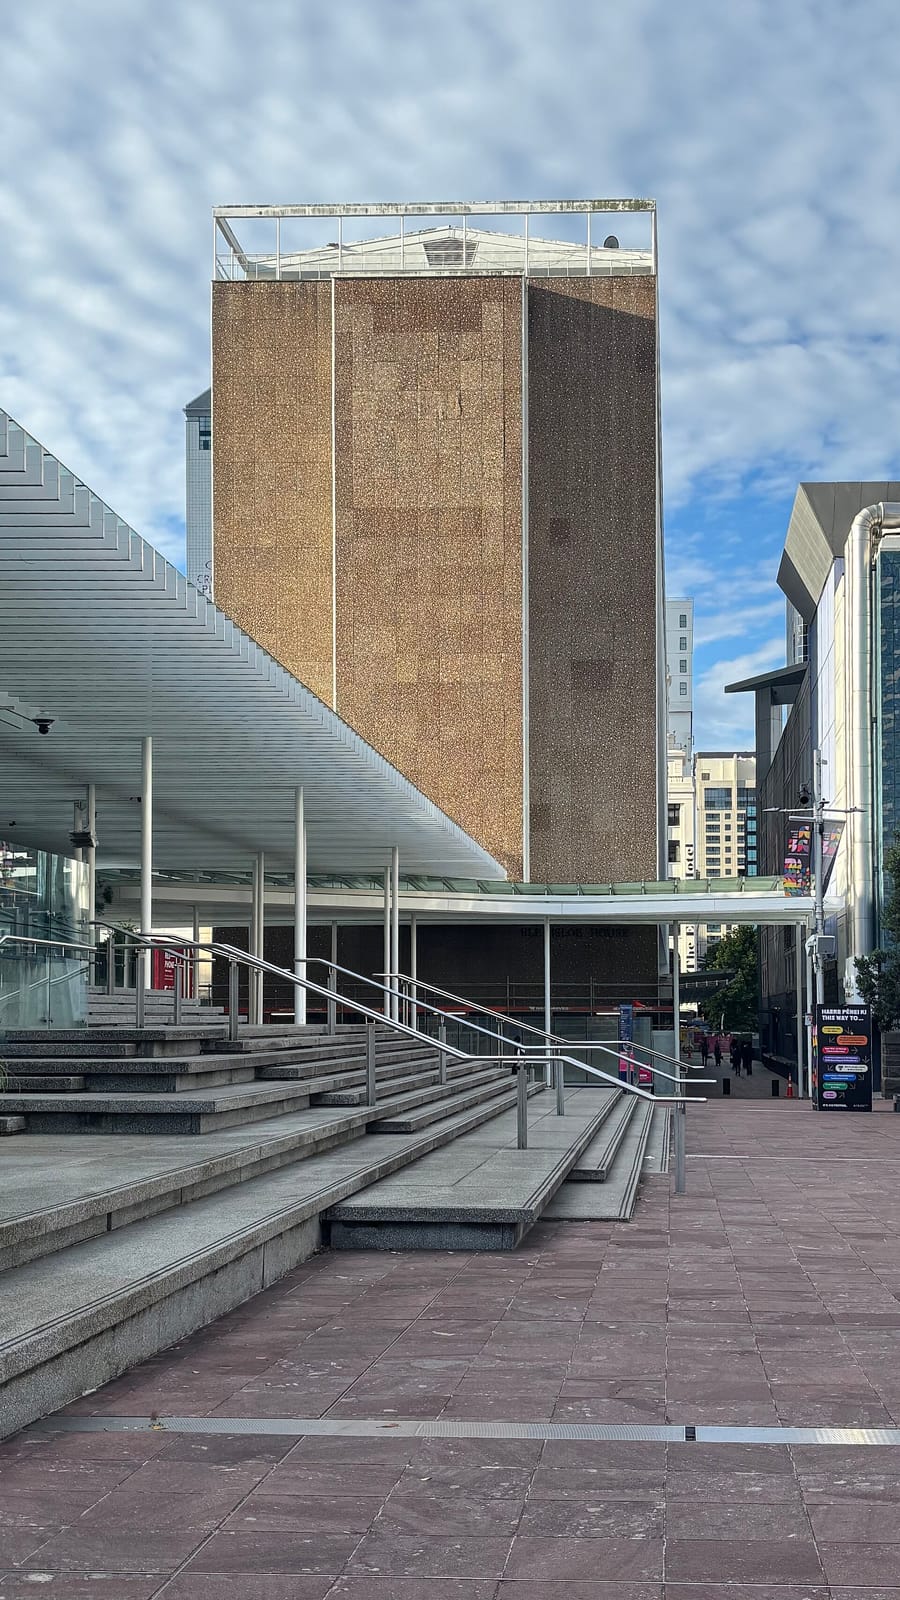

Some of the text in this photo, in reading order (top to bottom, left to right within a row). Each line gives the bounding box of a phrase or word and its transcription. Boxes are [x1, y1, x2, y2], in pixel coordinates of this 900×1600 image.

[197, 575, 212, 584] CR
[590, 927, 630, 938] HOUSE
[685, 942, 695, 973] The
